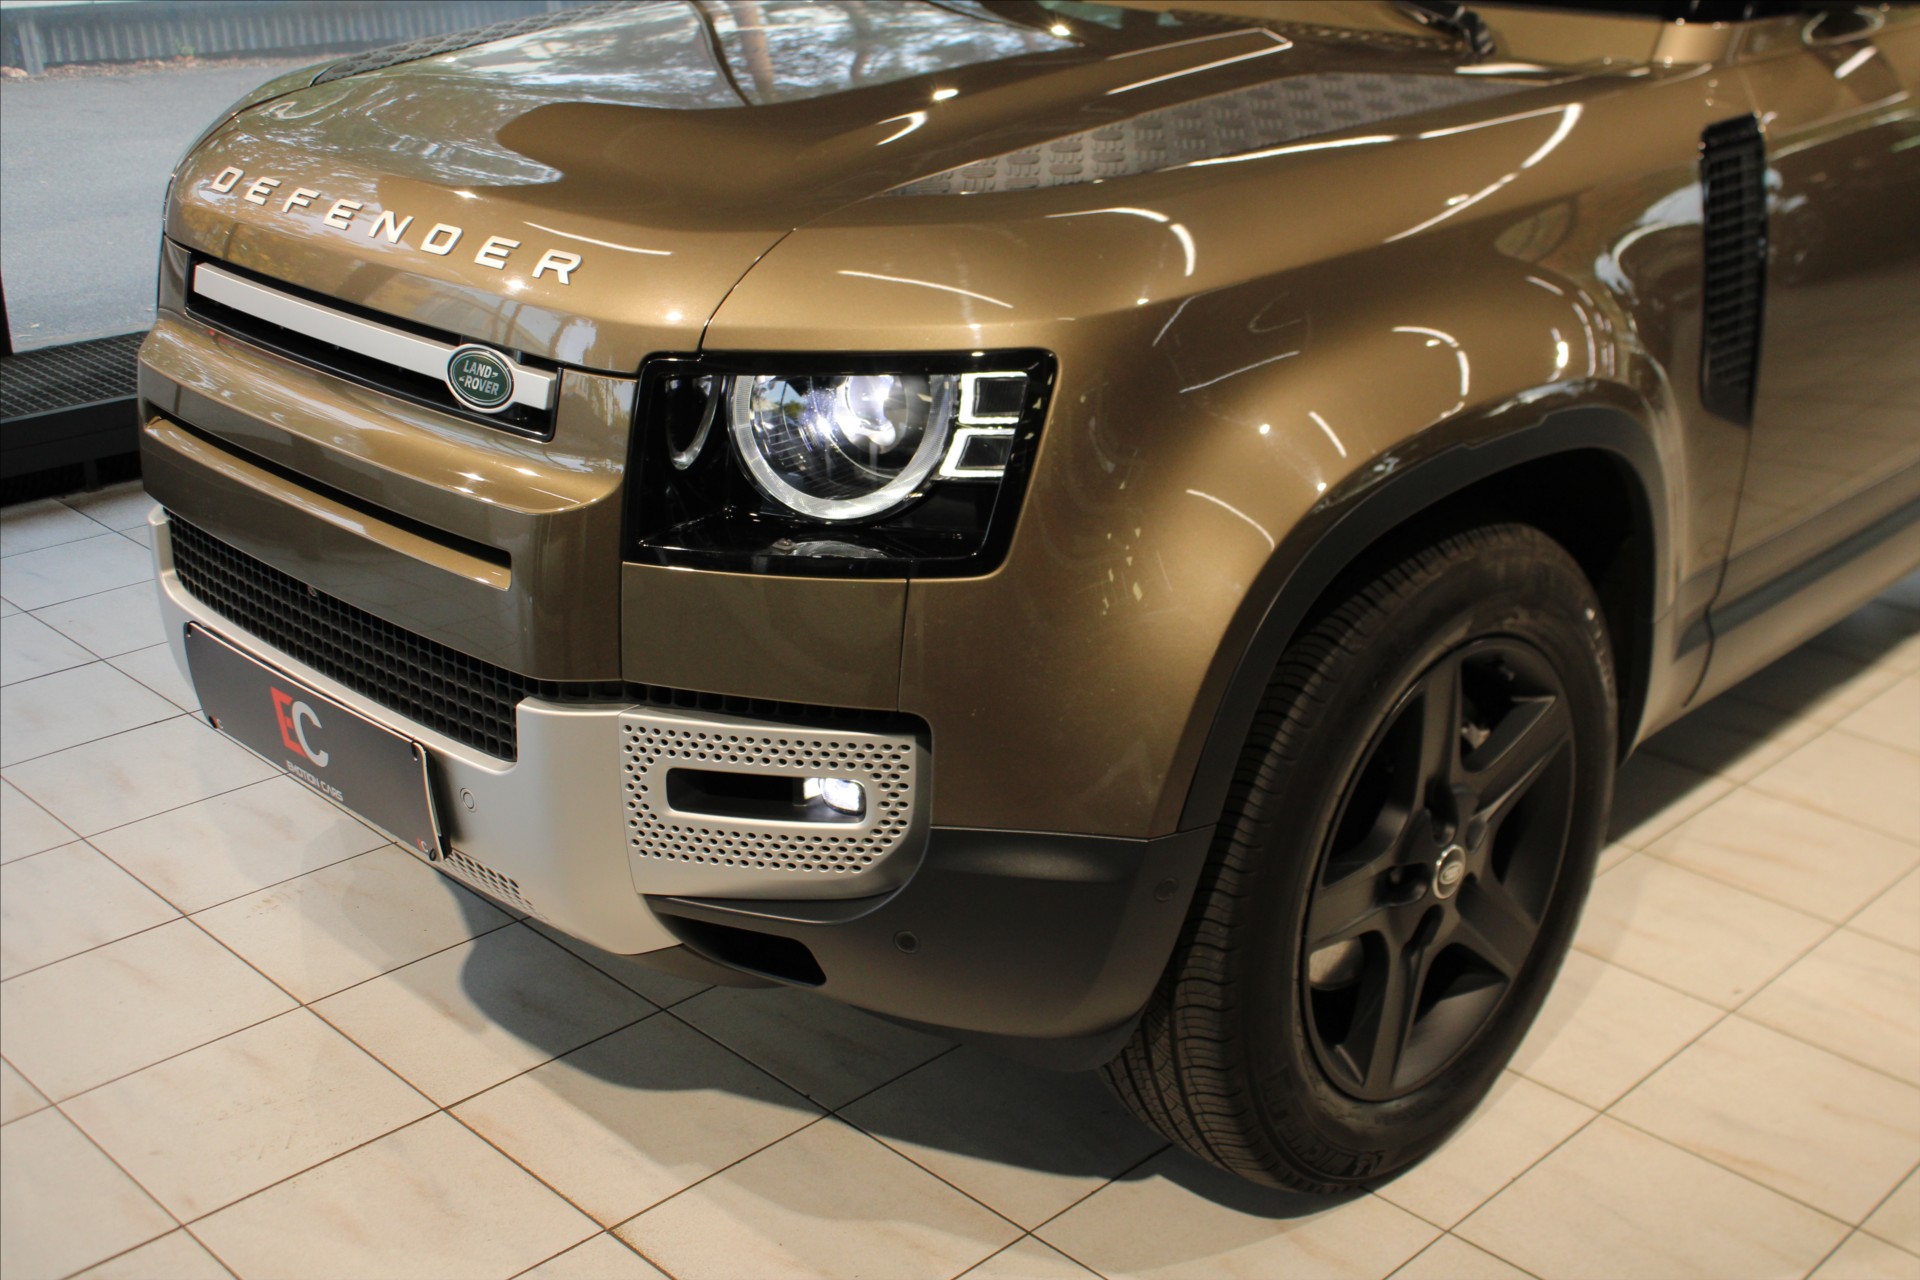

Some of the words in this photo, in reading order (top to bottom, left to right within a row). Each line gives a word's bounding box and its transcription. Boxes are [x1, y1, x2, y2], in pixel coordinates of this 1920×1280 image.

[212, 166, 583, 285] DEFENDER
[270, 686, 329, 768] EC
[319, 781, 344, 802] CARS
